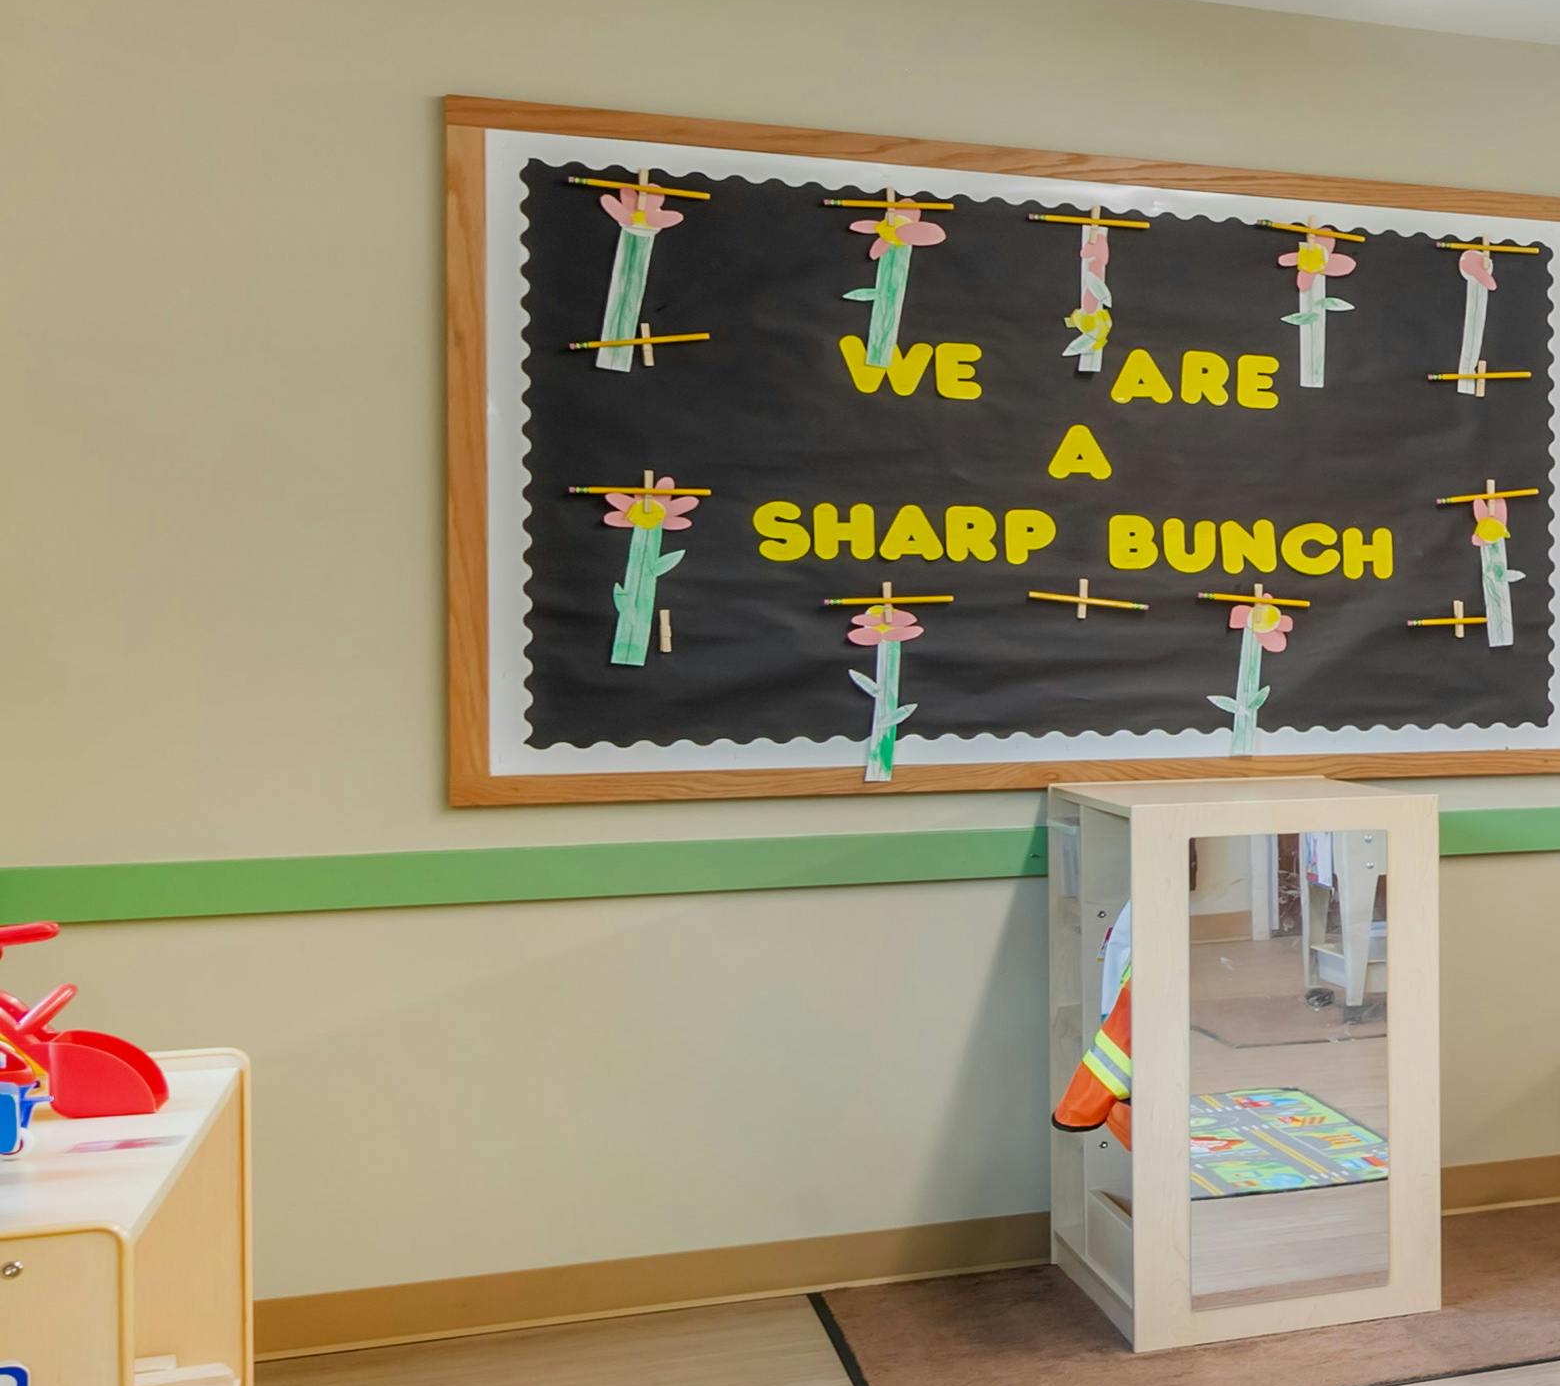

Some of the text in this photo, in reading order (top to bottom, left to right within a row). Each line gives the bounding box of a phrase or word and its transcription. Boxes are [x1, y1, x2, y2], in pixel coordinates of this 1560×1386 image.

[839, 334, 1282, 411] WE ARE
[1047, 423, 1114, 481] A
[752, 499, 1394, 580] SHARP BUNCH
